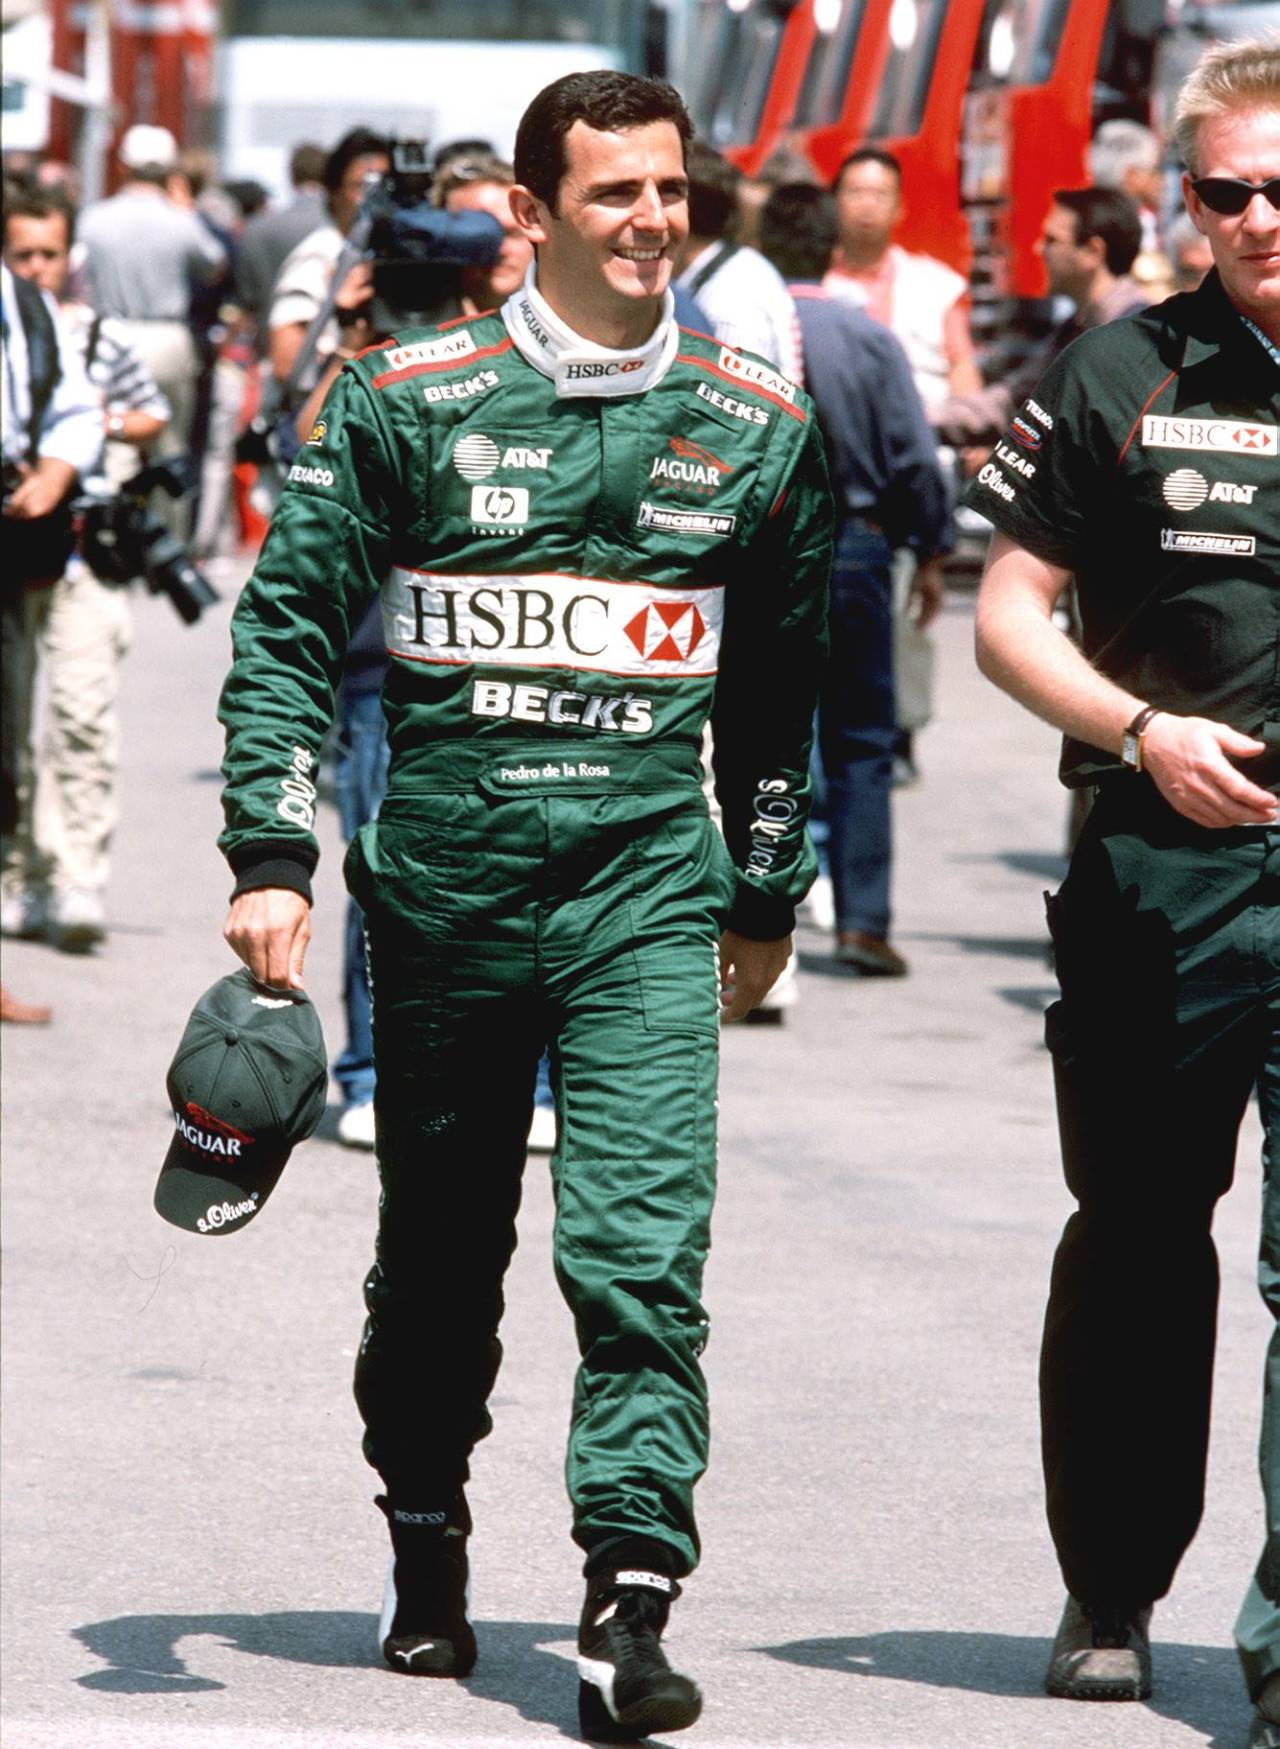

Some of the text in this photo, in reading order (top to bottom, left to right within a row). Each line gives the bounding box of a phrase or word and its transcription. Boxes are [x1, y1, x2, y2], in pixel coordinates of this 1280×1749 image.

[518, 300, 549, 348] JAGUAR
[566, 363, 619, 380] HSBC
[423, 370, 500, 403] BECK'S
[696, 382, 769, 425] BECK'S
[1148, 421, 1226, 446] HSBC
[501, 447, 554, 469] AT&T
[996, 446, 1036, 478] LEAR
[287, 465, 334, 487] TEXACO
[650, 456, 720, 487] JAGUAR
[1208, 481, 1259, 505] AT&T
[653, 512, 732, 531] MICHELIN
[1175, 535, 1251, 551] MICHELIN
[404, 584, 611, 657] HSBC
[471, 680, 654, 734] BECK'S
[501, 762, 610, 781] Pedro de la Rosa
